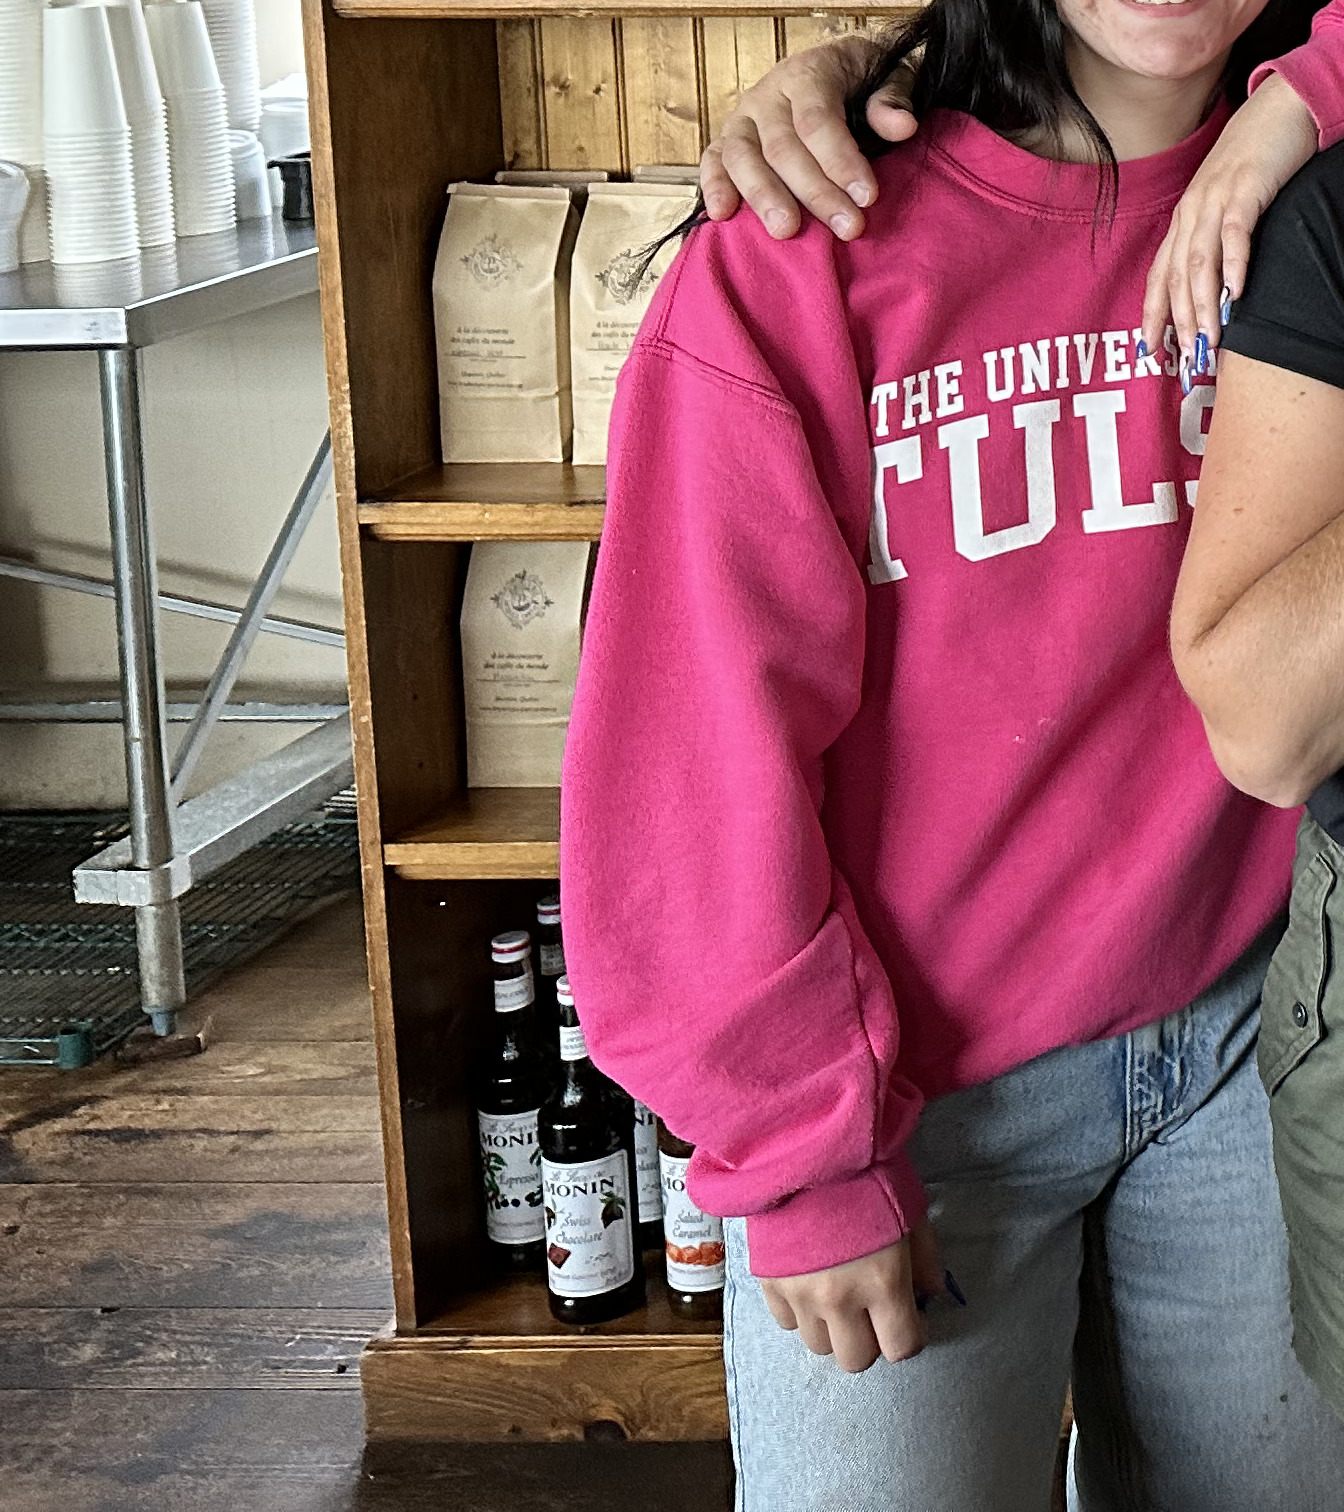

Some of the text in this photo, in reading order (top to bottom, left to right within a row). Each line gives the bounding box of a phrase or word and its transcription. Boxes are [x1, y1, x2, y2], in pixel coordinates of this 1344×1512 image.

[870, 324, 1217, 438] THE UNIVERS
[481, 1131, 534, 1148] MONI
[544, 1174, 615, 1198] MONIN
